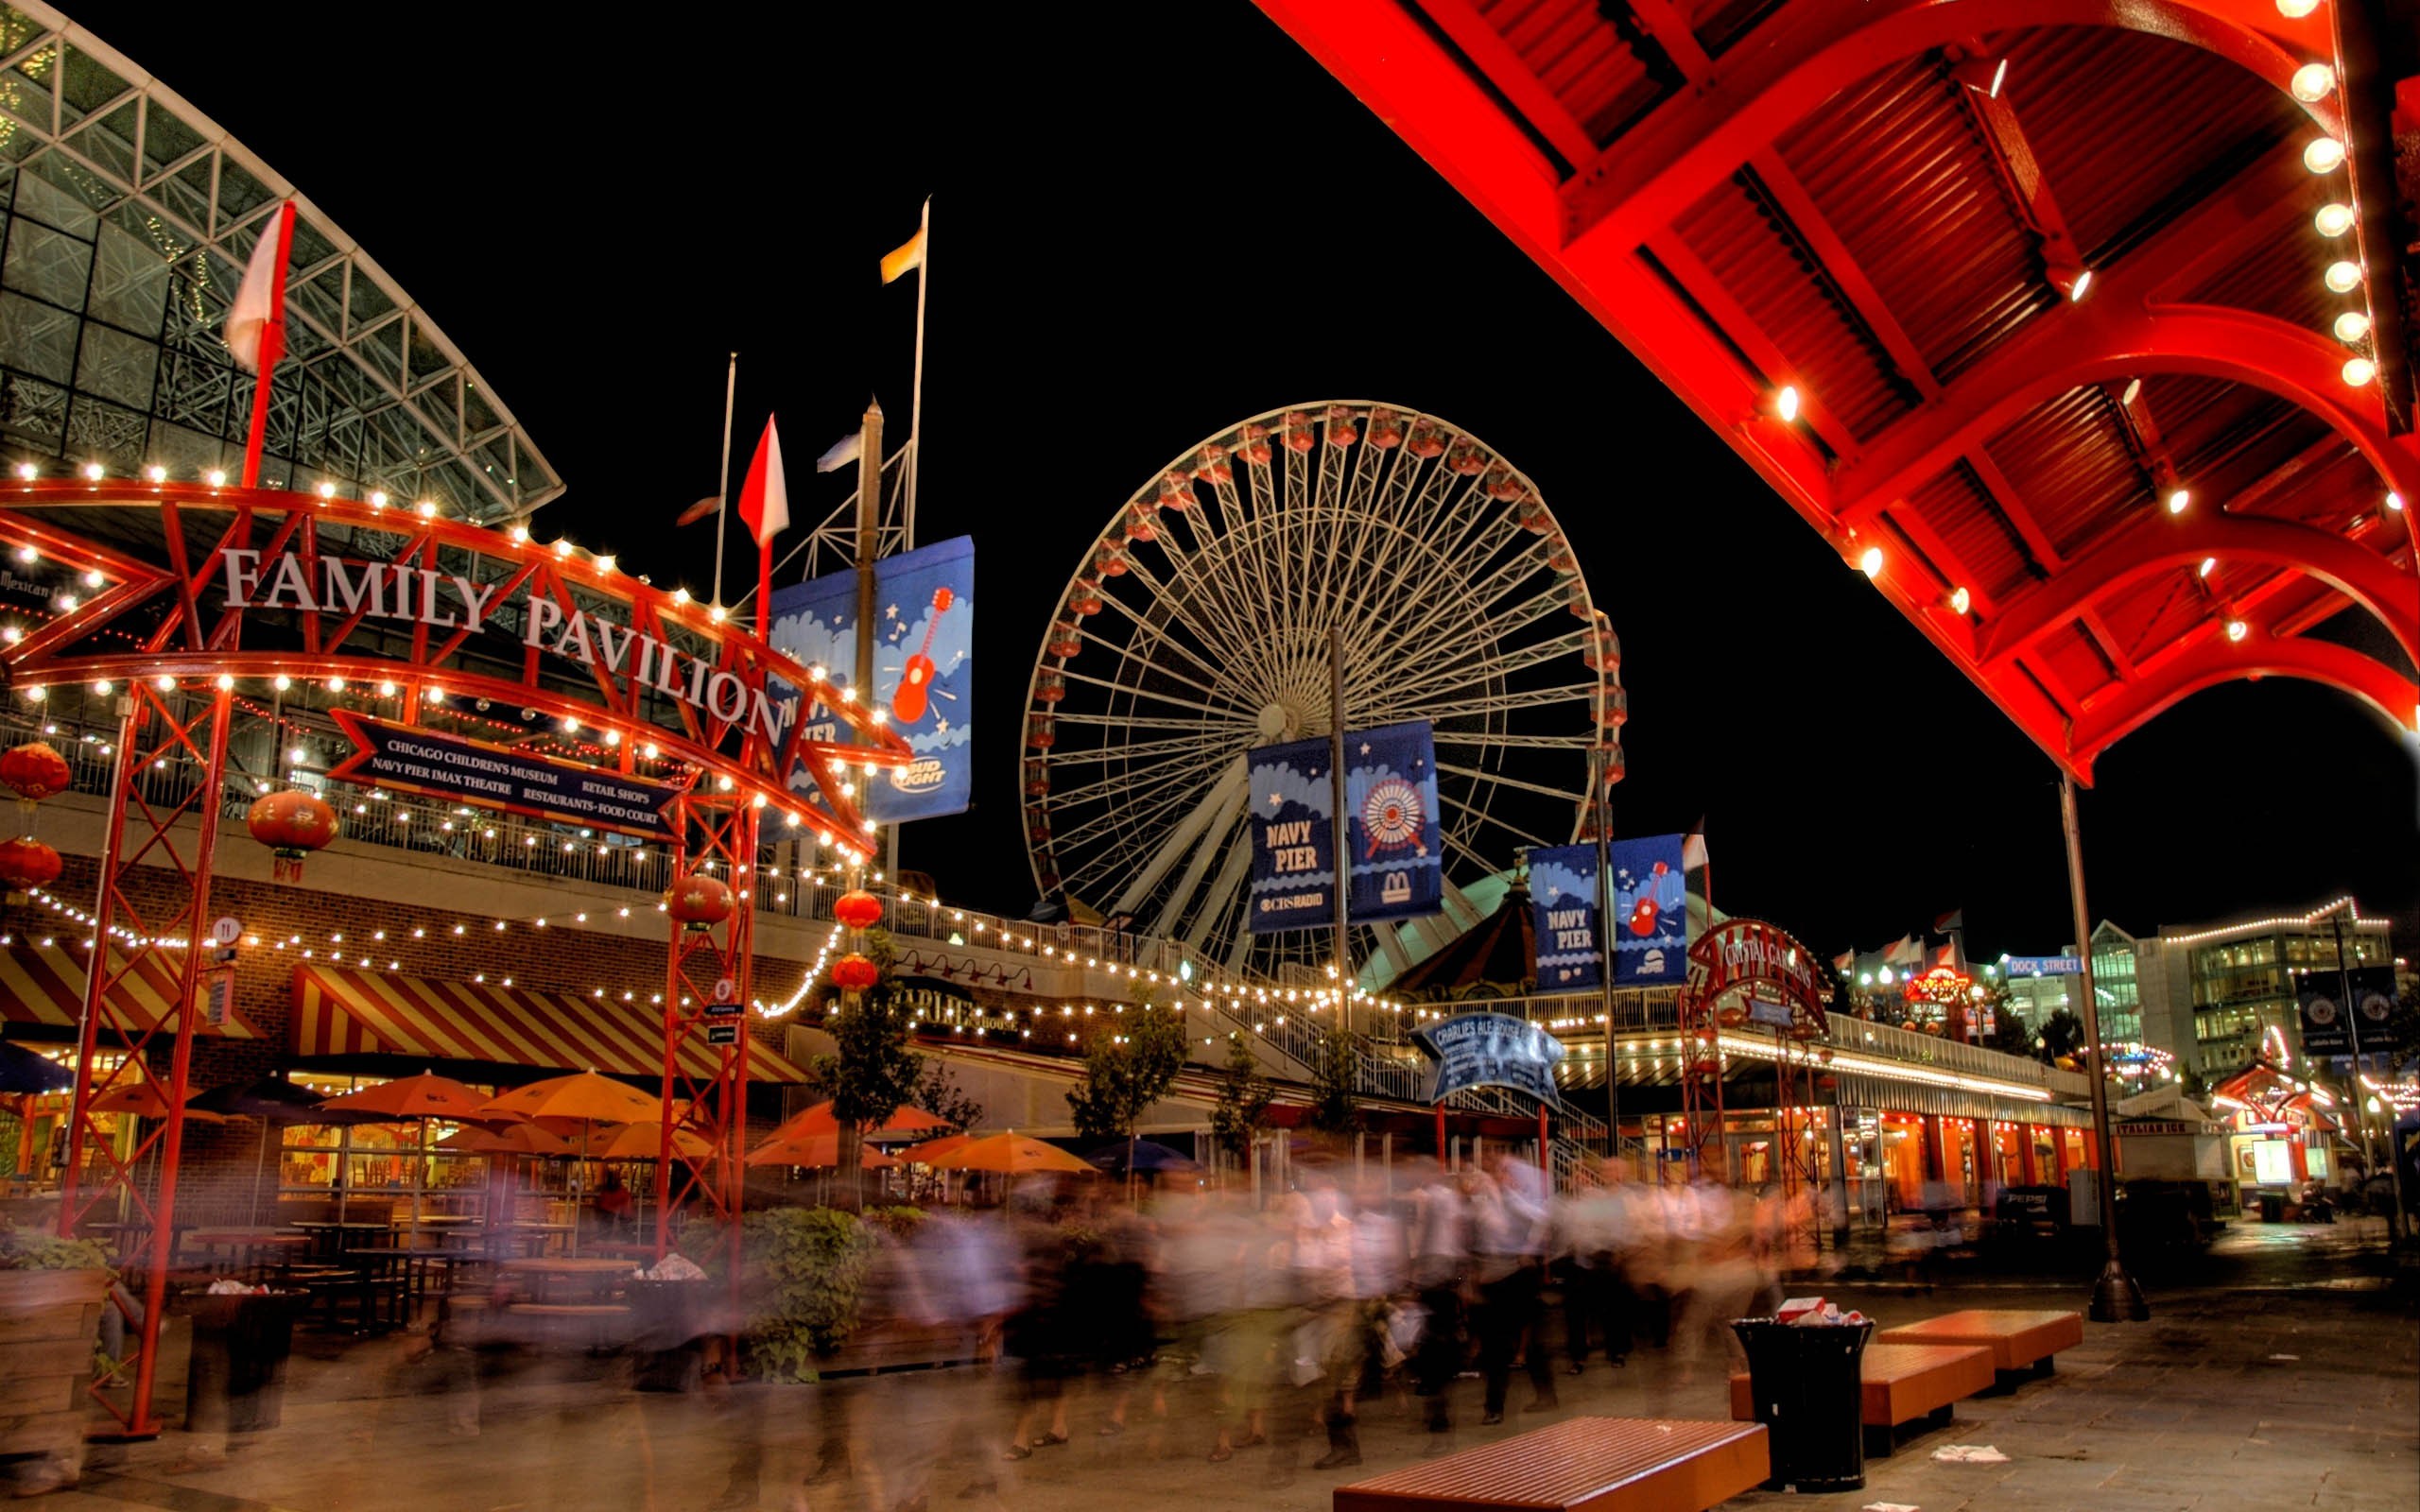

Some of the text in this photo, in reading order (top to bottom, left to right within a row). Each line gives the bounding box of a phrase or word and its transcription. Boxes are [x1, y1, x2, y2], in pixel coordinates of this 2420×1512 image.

[219, 548, 786, 747] FAMILY PAVILION
[387, 739, 559, 785] CHICAGO CHILDREN'S MUSEUM
[372, 757, 512, 796] NAVY PIER IMAX THEATRE
[581, 781, 650, 804] RETAIL SHOPS
[598, 803, 626, 818] FOOD
[626, 809, 660, 825] COURT
[1265, 819, 1312, 849] NAVY
[1275, 846, 1319, 873] PIER
[1547, 909, 1587, 930] NAVY
[1557, 929, 1593, 950] PIER
[1725, 939, 1767, 968] CRYSTAL
[2011, 959, 2078, 972] DOCK STREET
[2117, 1123, 2164, 1135] ITALIAN
[2166, 1122, 2187, 1134] ICE
[2008, 1193, 2048, 1205] PEPSI
